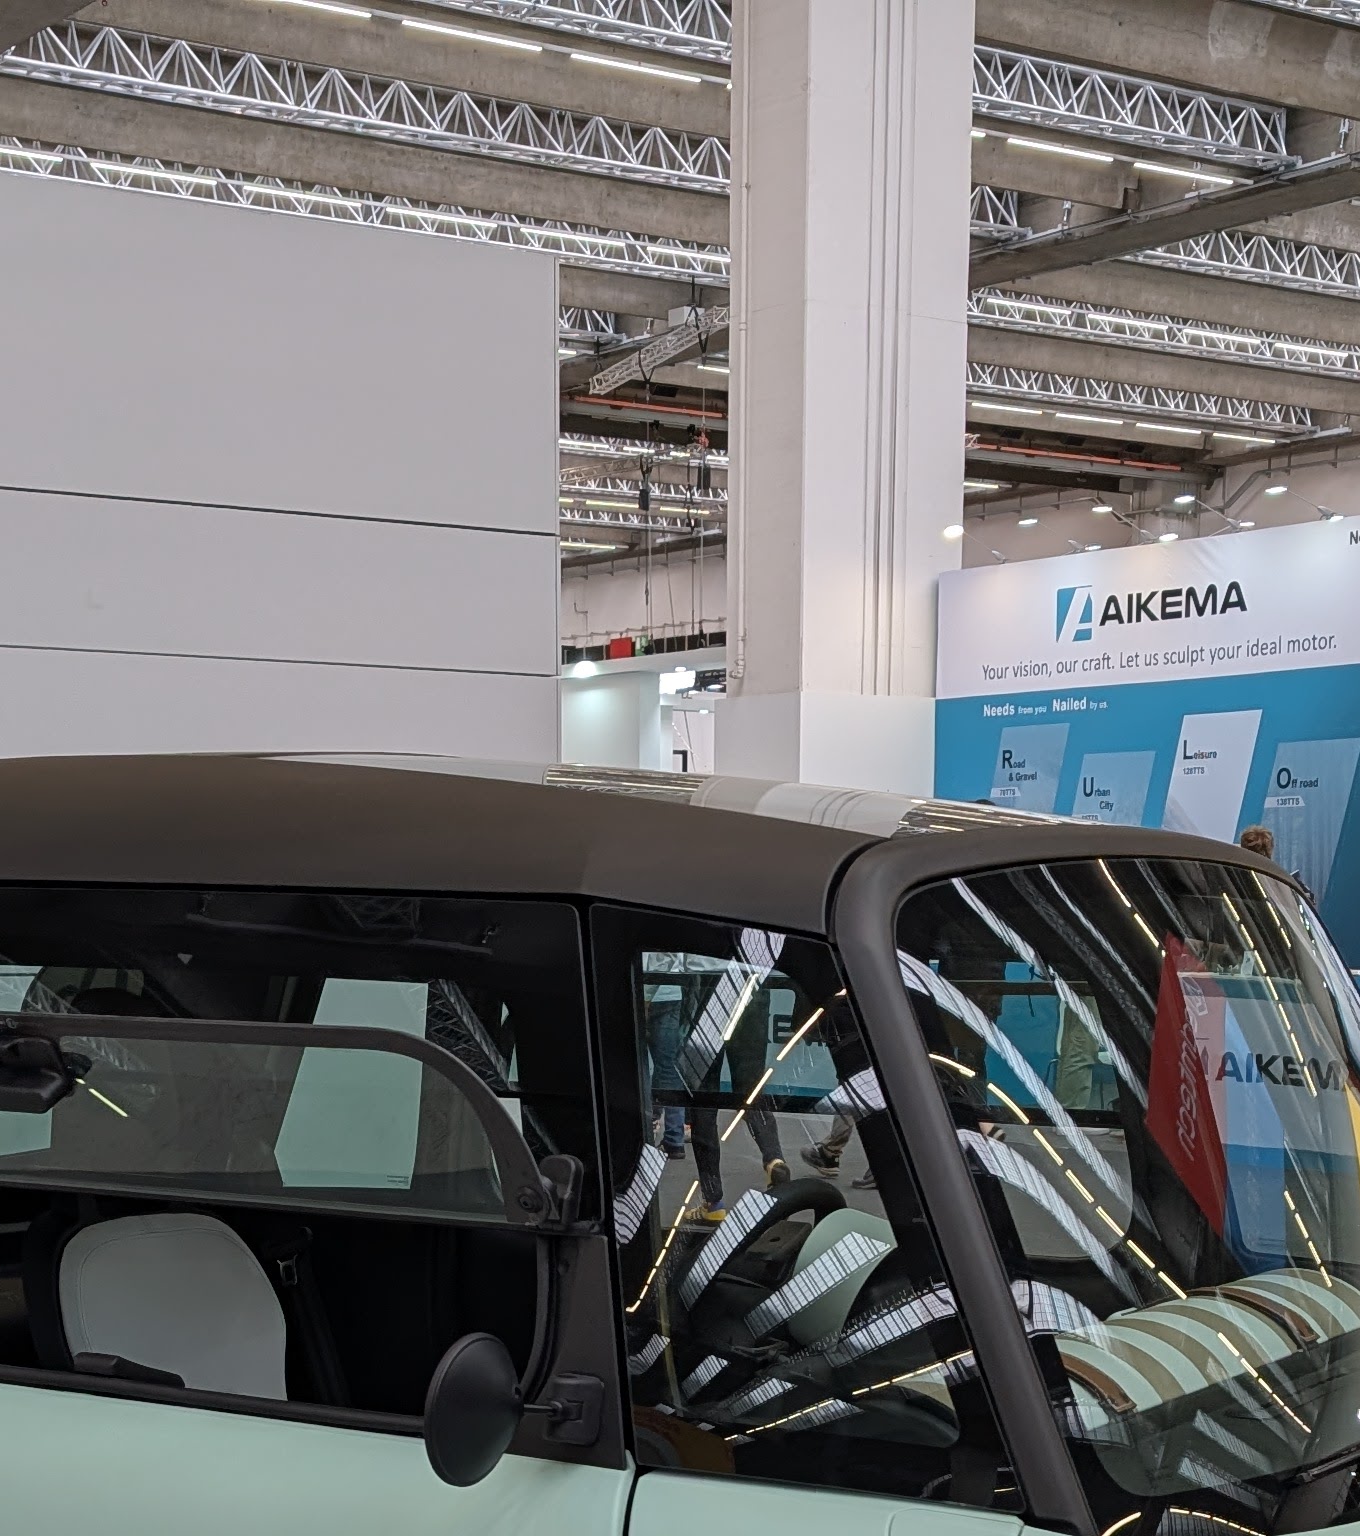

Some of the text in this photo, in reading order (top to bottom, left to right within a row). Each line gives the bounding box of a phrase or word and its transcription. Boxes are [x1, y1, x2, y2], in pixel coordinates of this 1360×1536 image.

[1099, 580, 1248, 627] AIKEMA
[982, 634, 1338, 681] Your vision, our craft. Let us sculpt your ideal motor.
[983, 703, 1015, 717] Needs
[1052, 697, 1087, 712] Nailed
[1002, 750, 1026, 769] Road
[1016, 771, 1038, 782] Gravel
[1276, 767, 1319, 789] Off road
[1083, 777, 1110, 797] Urban
[1100, 801, 1114, 812] City
